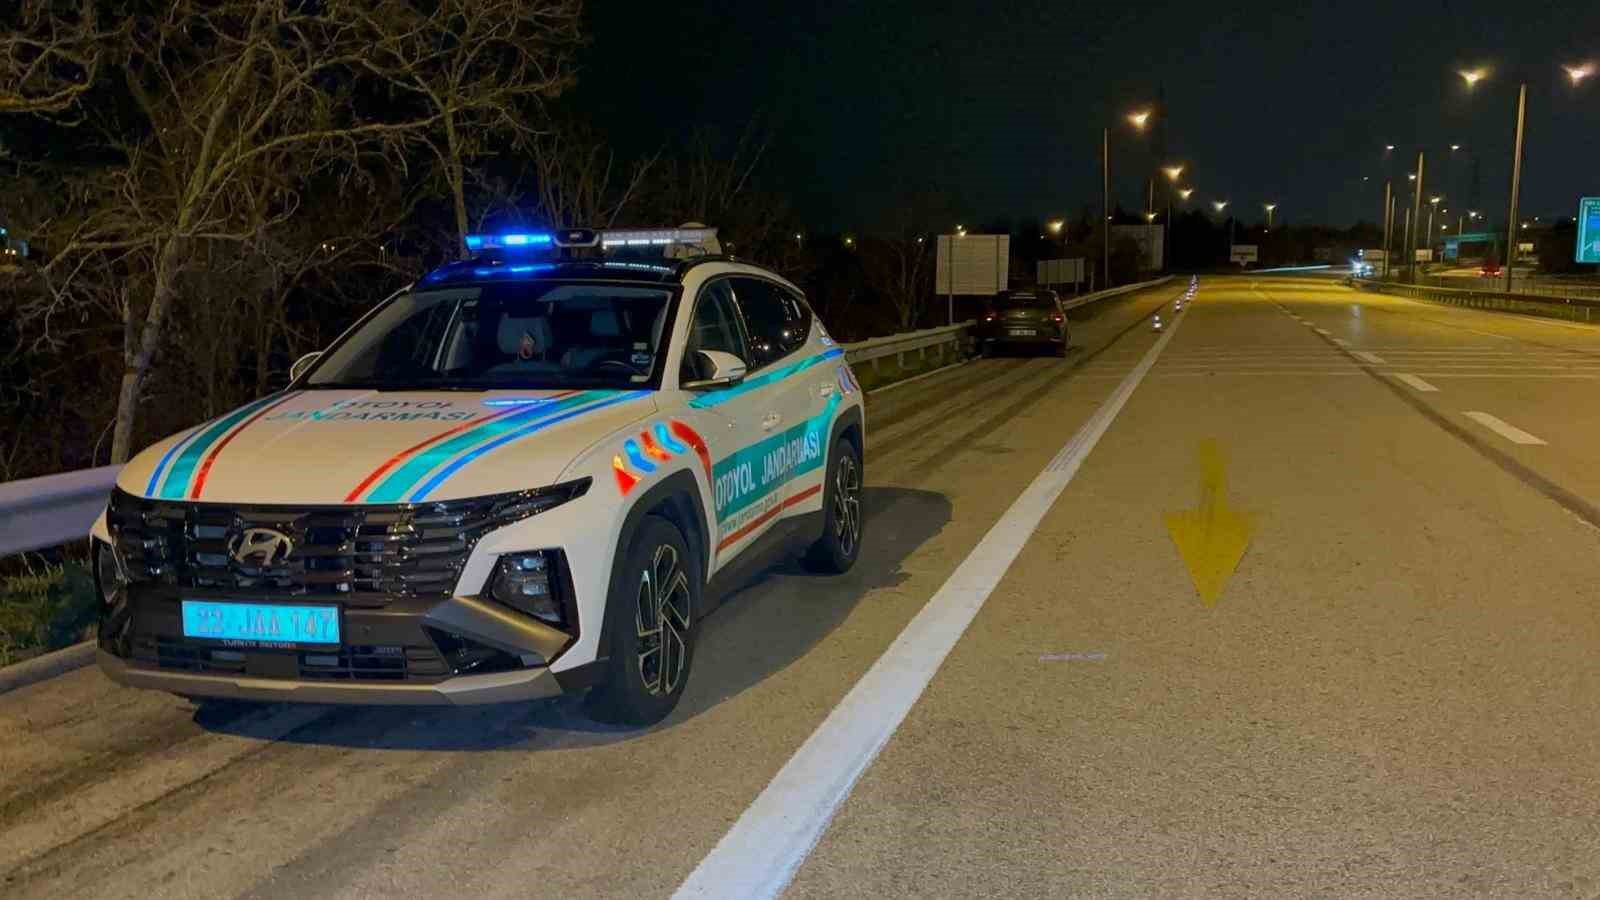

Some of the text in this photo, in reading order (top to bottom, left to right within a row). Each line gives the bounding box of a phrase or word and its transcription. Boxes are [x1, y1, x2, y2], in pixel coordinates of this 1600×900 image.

[265, 410, 479, 421] JANDARMASI
[331, 399, 454, 410] OTOYOL
[715, 461, 756, 512] OTOYOL
[761, 431, 820, 486] JANDARMASI
[196, 606, 224, 634] 22
[291, 610, 333, 640] 147
